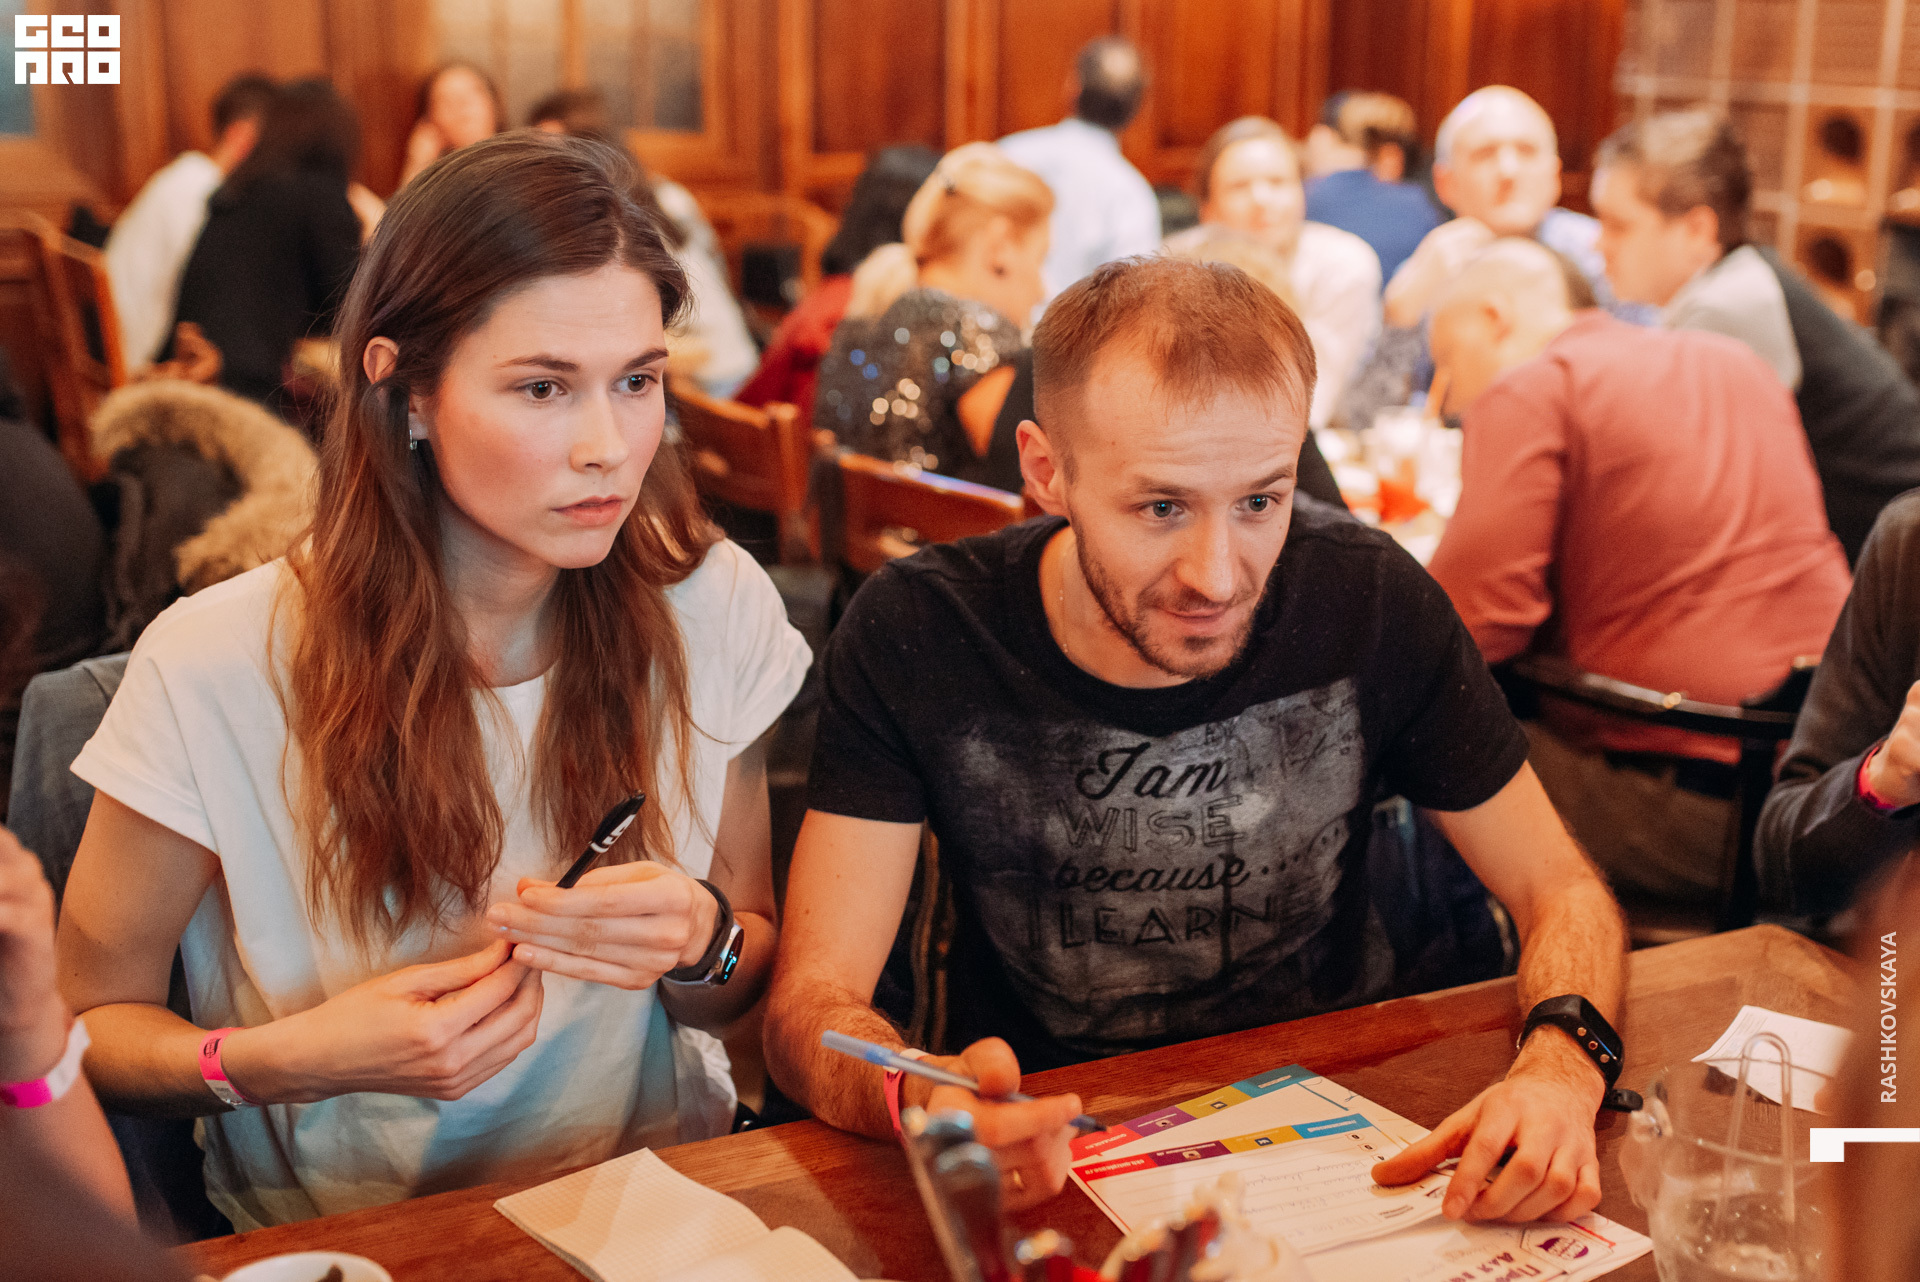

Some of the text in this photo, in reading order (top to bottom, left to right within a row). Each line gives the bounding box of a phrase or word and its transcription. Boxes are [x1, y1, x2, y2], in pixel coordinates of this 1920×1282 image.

[1133, 757, 1230, 799] am
[1057, 794, 1246, 852] WISE
[1058, 894, 1276, 949] LEARN
